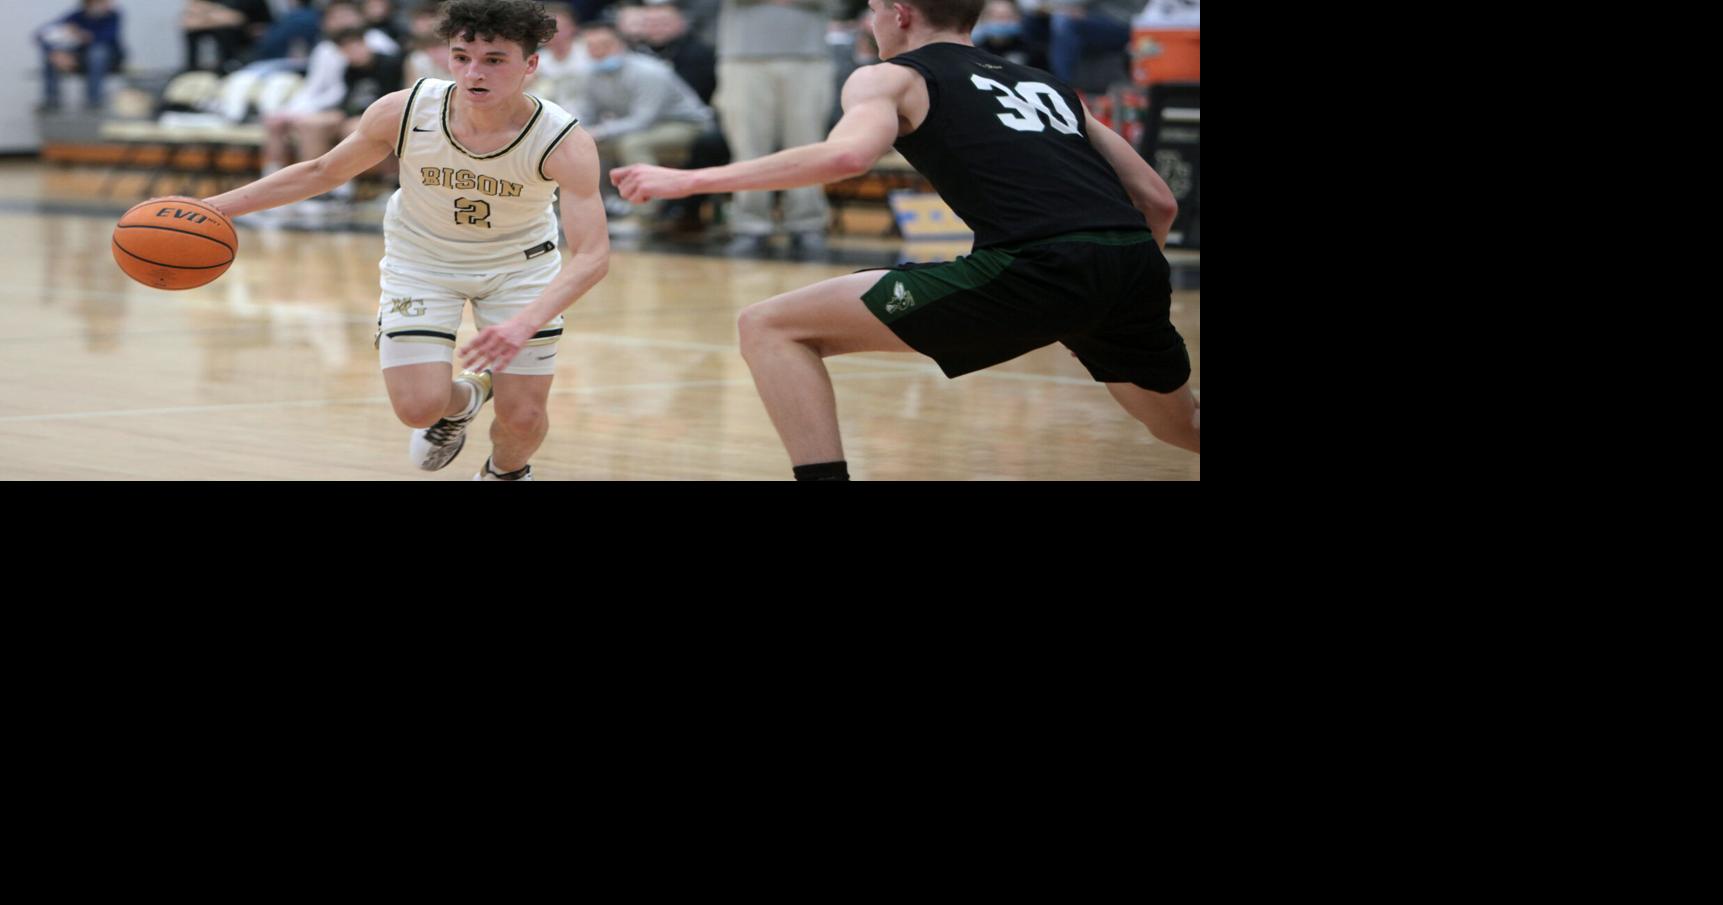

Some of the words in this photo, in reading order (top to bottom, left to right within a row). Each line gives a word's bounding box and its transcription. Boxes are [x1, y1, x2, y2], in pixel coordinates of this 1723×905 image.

[970, 73, 1082, 136] 30
[421, 167, 523, 197] BISON
[156, 207, 208, 224] EVO
[454, 196, 491, 228] 2
